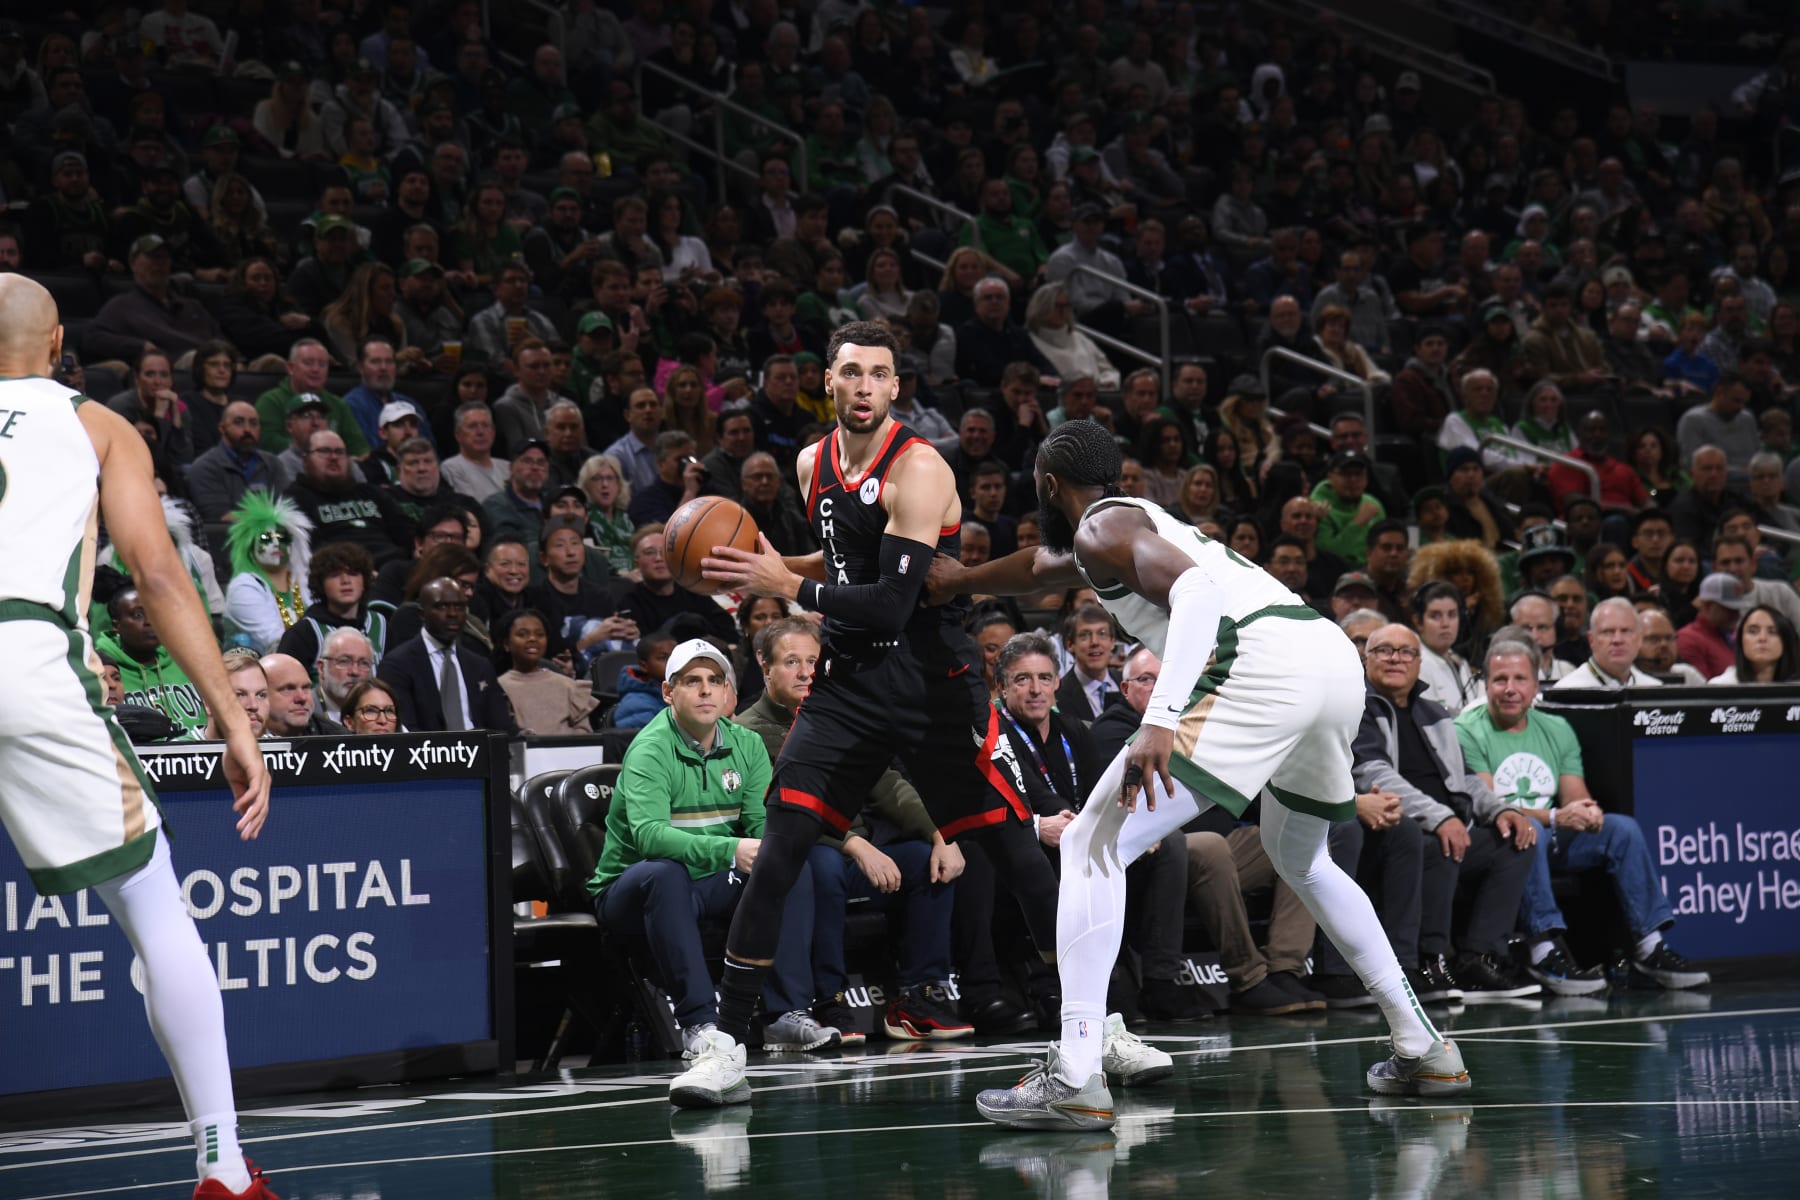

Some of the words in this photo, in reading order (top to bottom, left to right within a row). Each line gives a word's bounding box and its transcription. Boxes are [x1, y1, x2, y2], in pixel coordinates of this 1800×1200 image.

[1645, 725, 1679, 736] BOSTON
[1649, 708, 1686, 727] Sports
[1722, 722, 1755, 733] BOSTON
[1725, 706, 1762, 725] Sports
[322, 743, 394, 774] xfinity
[409, 739, 479, 770] xfinity
[1497, 757, 1552, 787] CELTICS
[1658, 821, 1729, 865] Beth
[5, 882, 109, 931] IAL
[180, 859, 430, 920] OSPITAL
[1758, 870, 1800, 910] He
